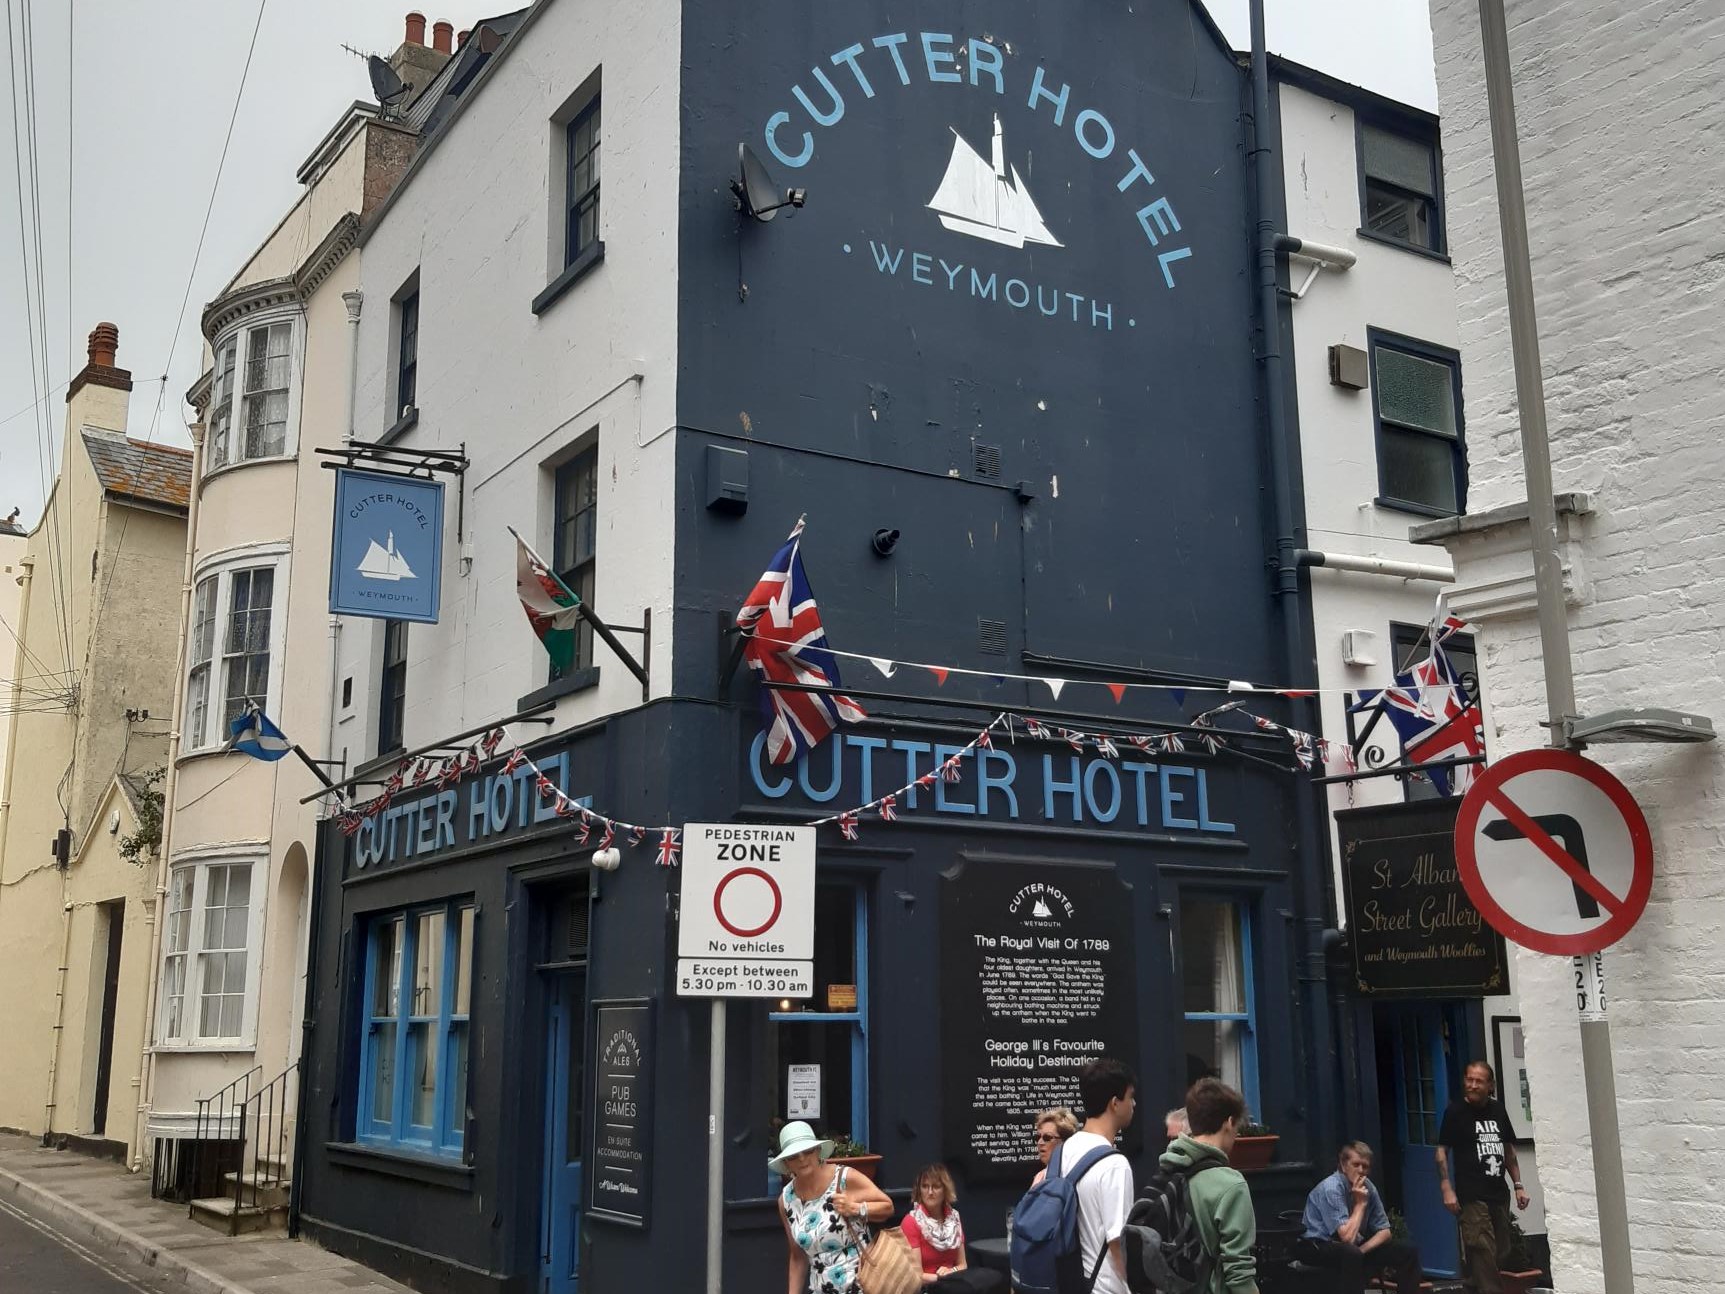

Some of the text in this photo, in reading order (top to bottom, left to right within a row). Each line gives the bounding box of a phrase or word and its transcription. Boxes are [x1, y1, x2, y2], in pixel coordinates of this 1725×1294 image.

[765, 32, 1192, 288] CUTTER HOTEL
[870, 240, 1112, 330] WEYMOUTH
[350, 494, 428, 529] CUTTER HOTEL
[358, 591, 413, 603] WEYMOUTH
[750, 733, 1236, 832] CUTTER HOTEL
[356, 751, 593, 869] CUTTER HOTEL
[705, 829, 795, 841] PEDESTRIAN
[717, 844, 781, 862] ZONE
[1371, 859, 1393, 889] St
[1009, 883, 1074, 918] CUTTER HOTEL
[1361, 892, 1482, 938] Street Gallery
[709, 941, 785, 953] No vehicles
[975, 935, 1109, 950] The Royal Visit Of 1789
[998, 956, 1011, 965] King,
[1014, 957, 1036, 965] together
[1364, 948, 1383, 962] and
[1386, 945, 1438, 964] Weymouth
[693, 965, 798, 979] Except between
[1074, 966, 1103, 974] Weymouth
[682, 978, 808, 992] 5.30 pm 10.30 am
[983, 987, 1002, 995] played
[603, 1030, 641, 1067] TRADITIONAL
[985, 1039, 1105, 1053] George III's Favourite
[613, 1056, 630, 1066] ALES
[990, 1056, 1034, 1069] Holiday
[612, 1086, 630, 1100] PUB
[1044, 1092, 1075, 1100] Weymouth
[605, 1101, 636, 1117] GAMES
[1006, 1123, 1020, 1131] King
[1475, 1120, 1500, 1133] AIR
[616, 1137, 631, 1147] SUITE
[989, 1139, 1010, 1147] serving
[597, 1147, 642, 1161] ACCOMMODATION
[984, 1147, 1016, 1155] Weymouth
[991, 1155, 1017, 1163] elevating
